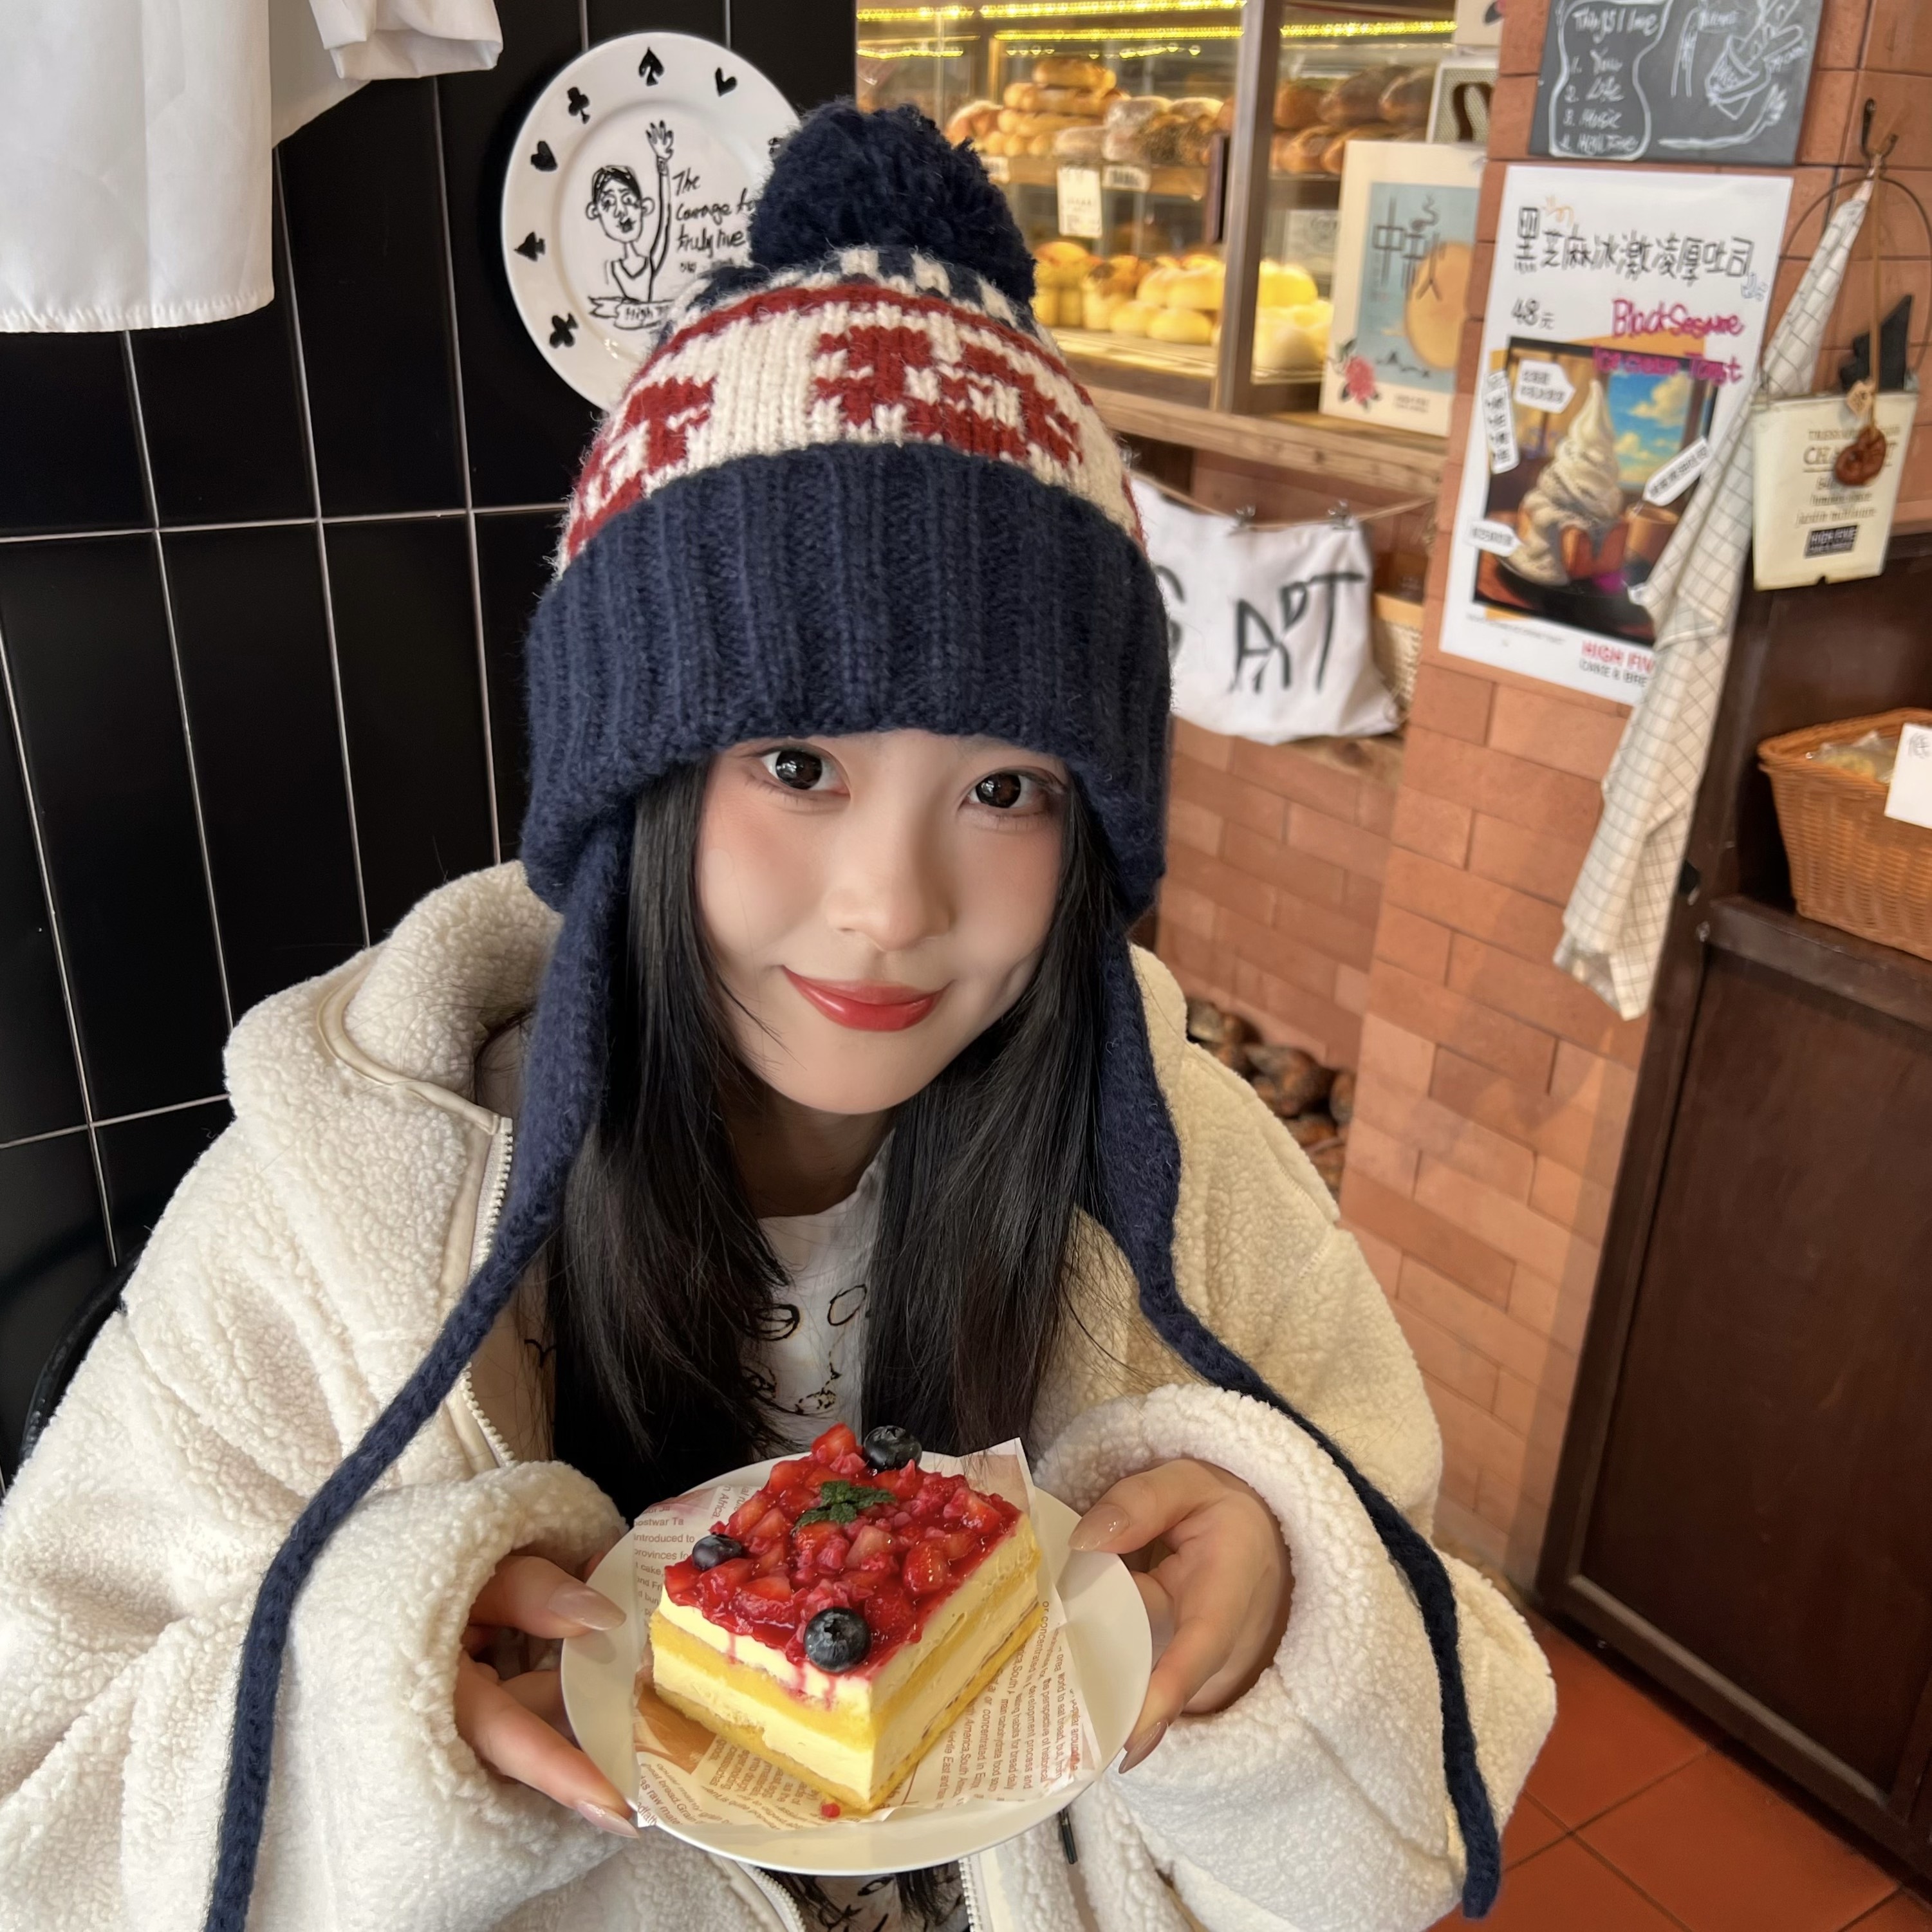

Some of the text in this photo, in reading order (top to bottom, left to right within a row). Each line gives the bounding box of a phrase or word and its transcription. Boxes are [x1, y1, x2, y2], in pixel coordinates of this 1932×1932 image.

[672, 167, 700, 196] The
[677, 224, 713, 258] truly
[1514, 206, 1754, 286] 黑芝麻冰激凌厚吐司
[1228, 571, 1366, 694] APT
[634, 1534, 695, 1543] introduced to
